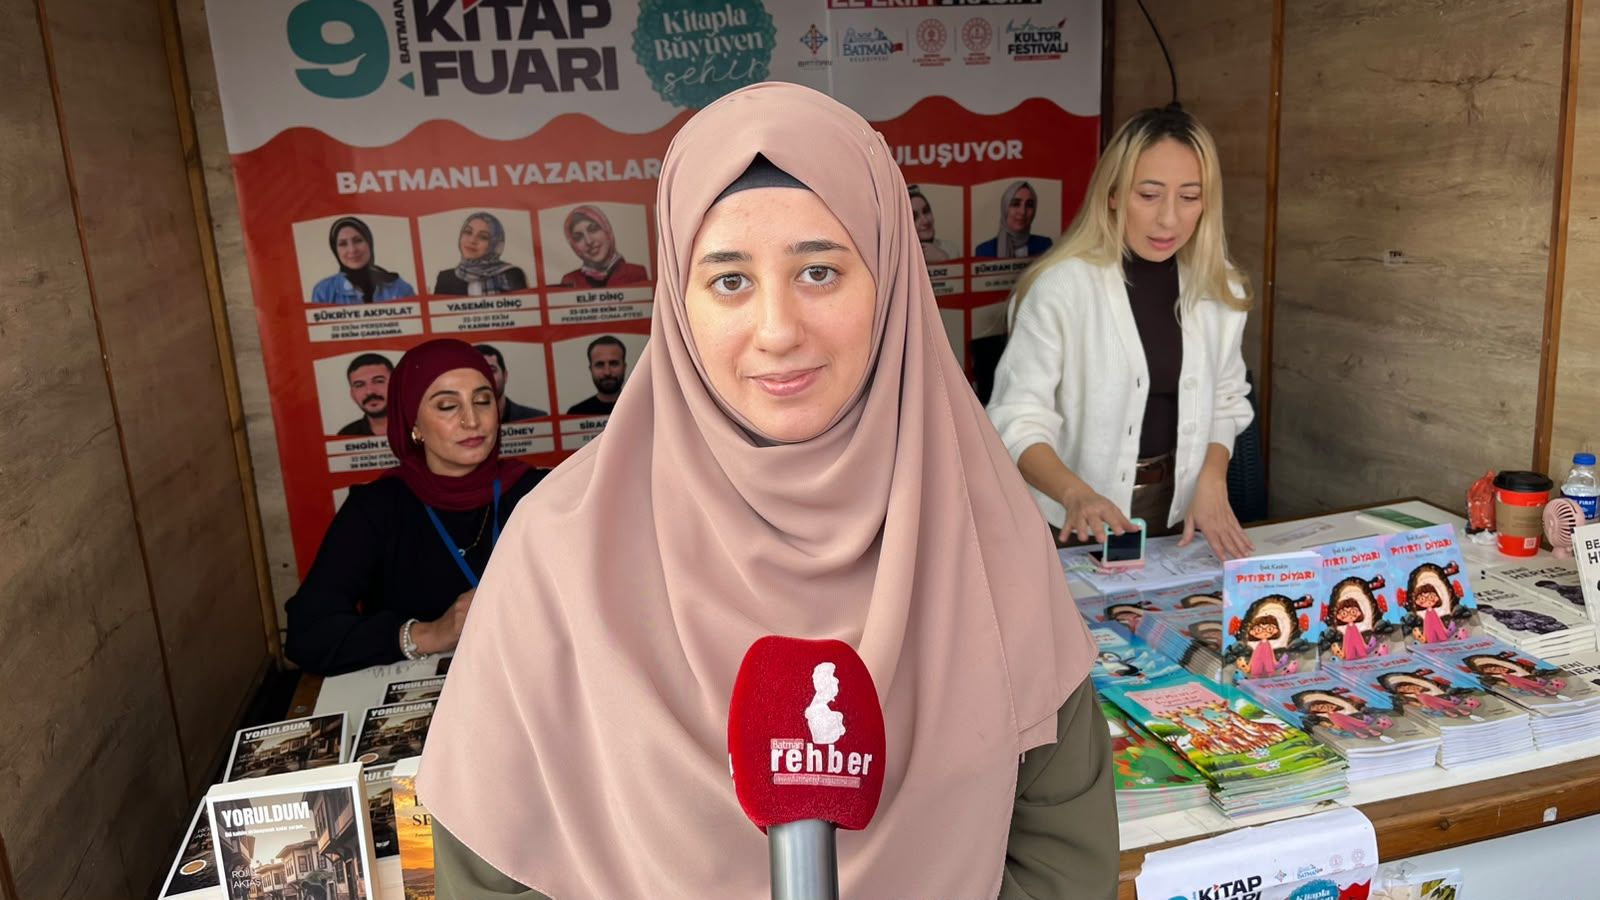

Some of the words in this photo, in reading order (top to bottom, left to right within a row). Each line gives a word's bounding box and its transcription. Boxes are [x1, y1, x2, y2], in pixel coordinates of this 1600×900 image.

[394, 0, 411, 64] BATMAN
[413, 0, 612, 42] KİTAP
[662, 3, 748, 35] Kitapla
[286, 0, 391, 99] 9
[654, 31, 765, 62] Büyüyen
[418, 46, 620, 97] FUARI
[890, 138, 1024, 169] ULUŞUYOR
[336, 165, 498, 194] BATMANLI
[447, 299, 495, 312] YASEMİN
[496, 297, 522, 309] DİNÇ
[576, 293, 597, 303] ELİF
[313, 307, 361, 323] ŞÜKRİYE
[363, 305, 413, 319] AKPULAT
[345, 440, 379, 451] ENGİN
[1322, 556, 1348, 568] ITIRTI
[1236, 573, 1275, 584] PITIRTI
[1279, 569, 1315, 582] DİYARI
[371, 702, 433, 717] YORULDUM
[245, 720, 311, 740] YORULDUM
[771, 740, 804, 750] Batman
[770, 742, 873, 776] rehber
[221, 801, 310, 828] YORULDUM
[1198, 875, 1262, 900] KİTAP
